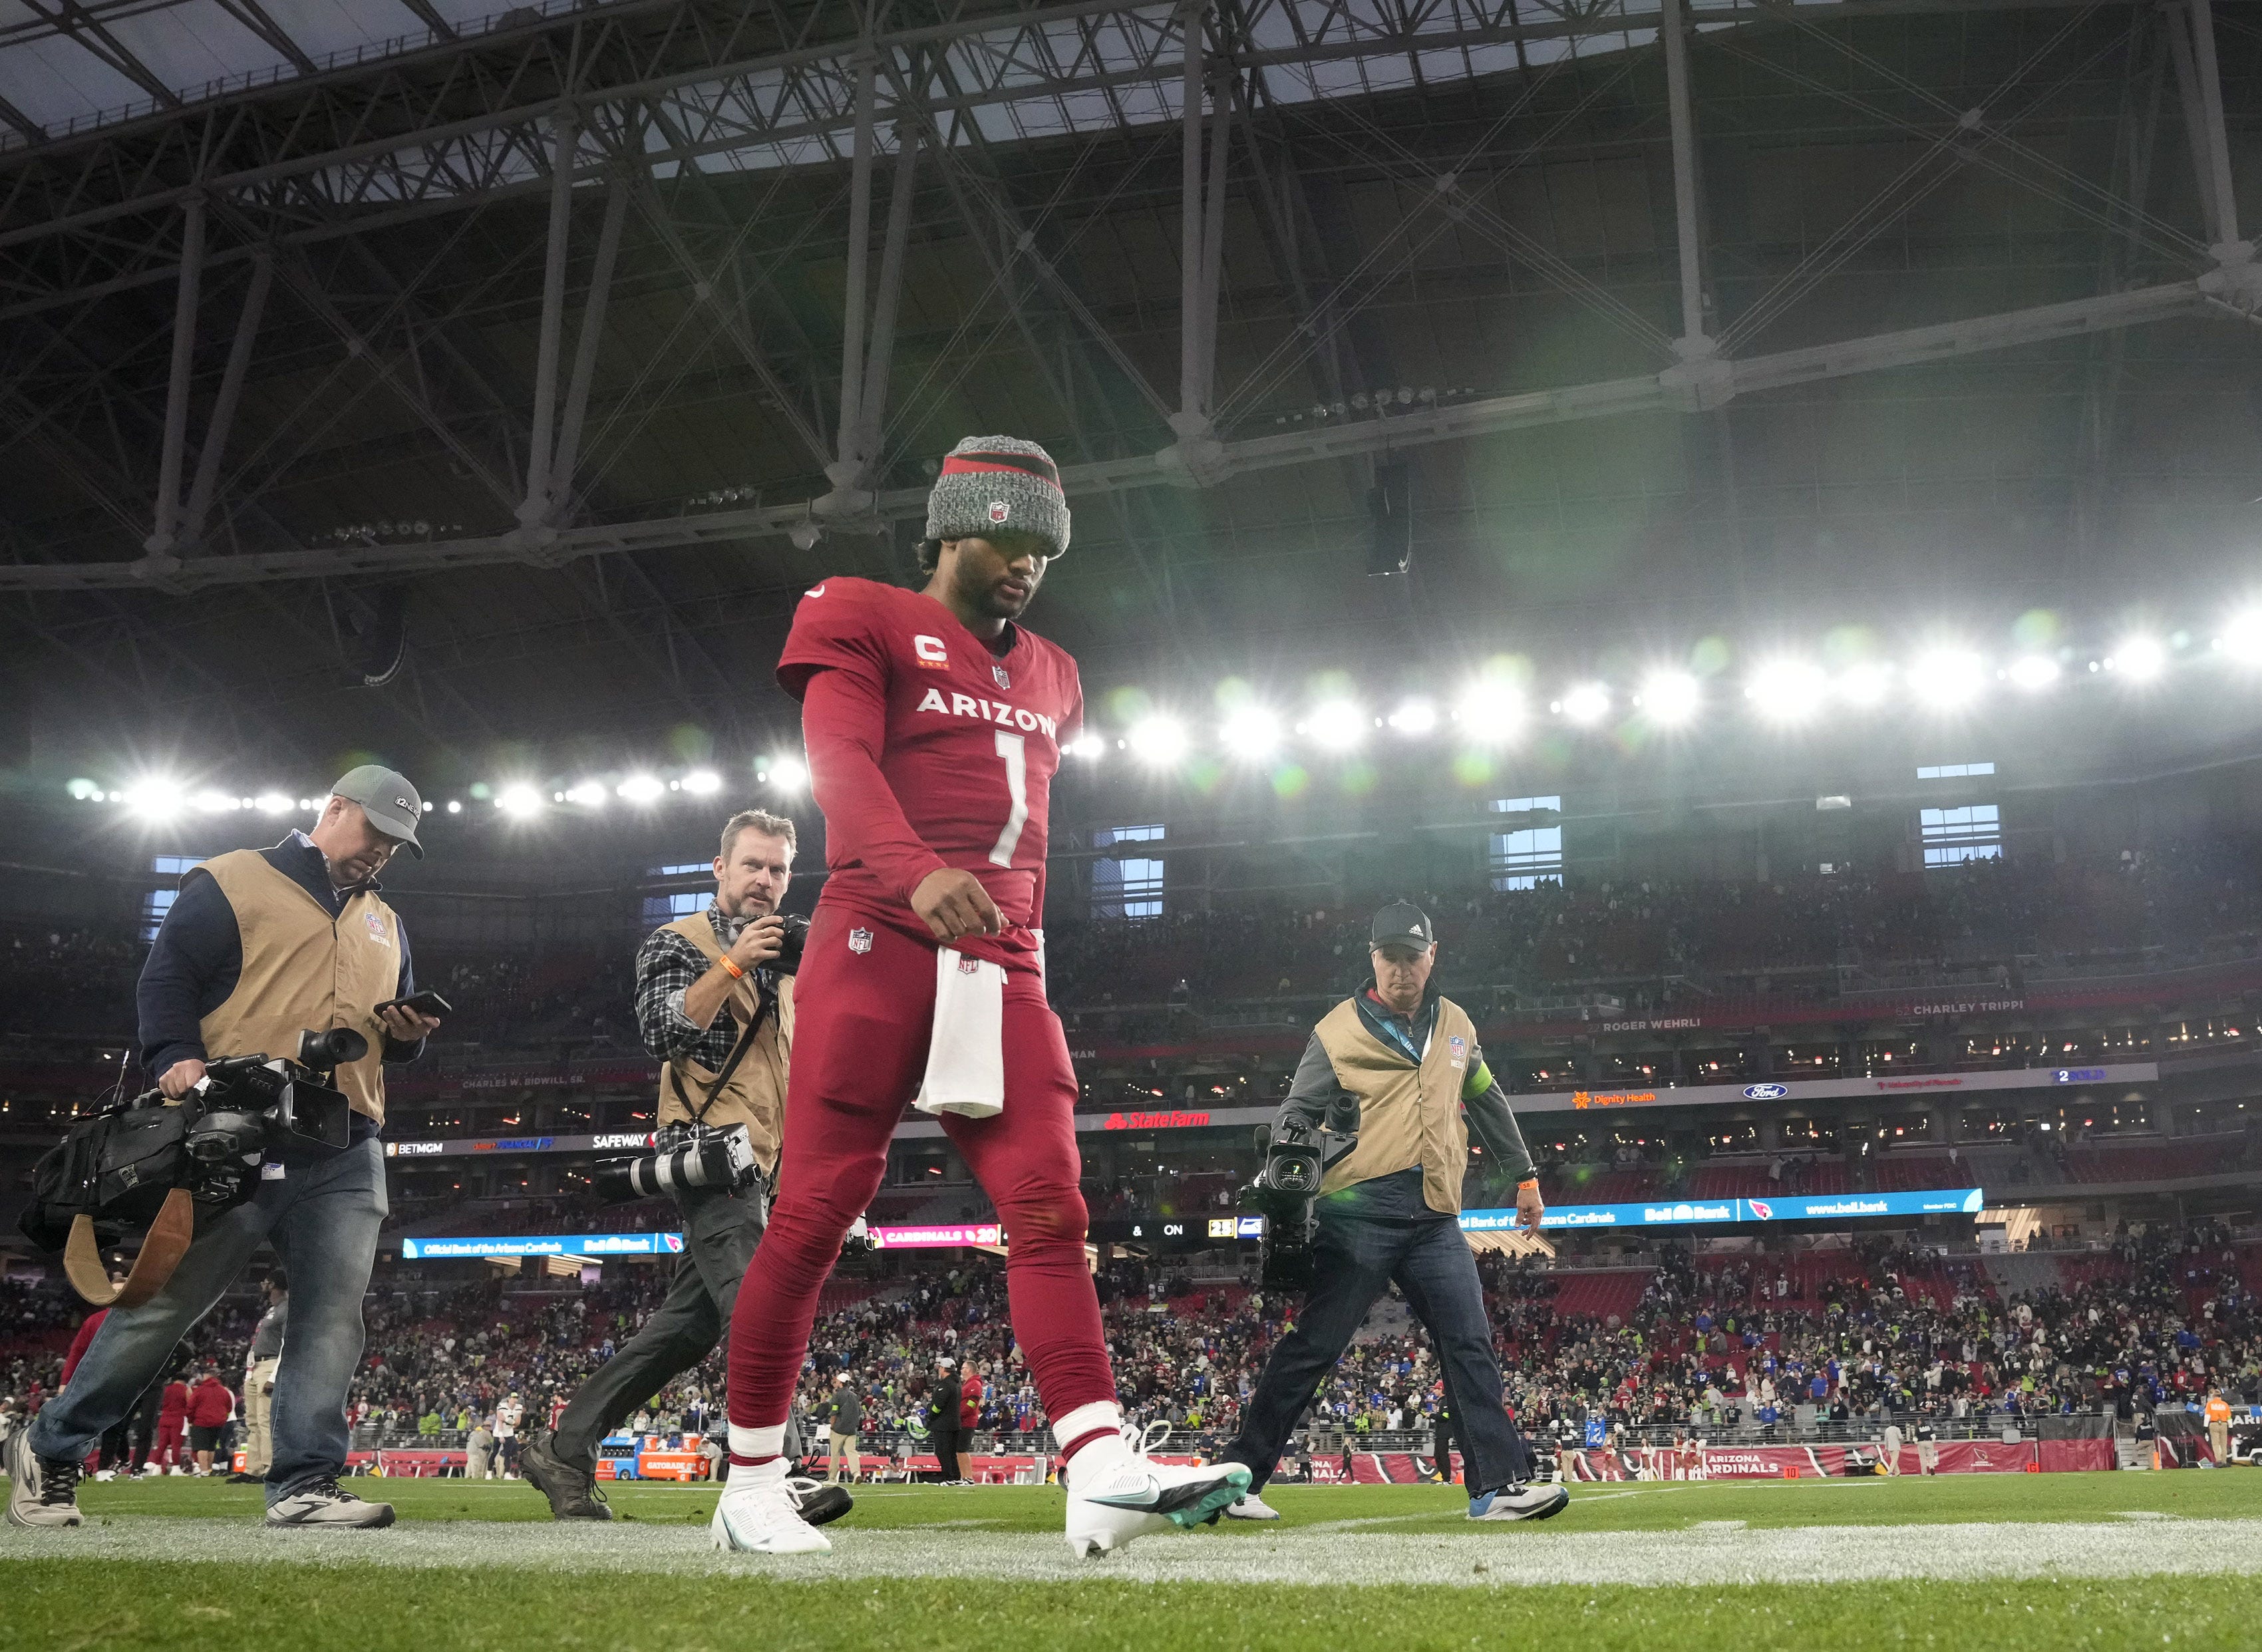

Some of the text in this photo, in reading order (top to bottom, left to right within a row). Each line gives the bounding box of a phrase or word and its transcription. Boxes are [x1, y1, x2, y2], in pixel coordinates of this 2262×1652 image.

[914, 634, 947, 662] C
[916, 688, 1056, 740] ARIZON
[989, 730, 1029, 869] 1
[959, 959, 977, 971] NFL
[1913, 1003, 1975, 1015] CHARLEY
[1980, 1000, 2023, 1011] TRIPPI
[1603, 1021, 1646, 1031] ROGER
[1651, 1018, 1700, 1029] WEHRLI
[462, 1078, 507, 1088] CHARLES
[1751, 1086, 1779, 1098] Ford
[1594, 1092, 1655, 1106] Dignity Health
[593, 1134, 647, 1148] SAFEWAY
[398, 1142, 443, 1154] BETMGM
[1645, 1205, 1730, 1222] Bell Bank
[1806, 1200, 1887, 1215] www.bell.bank
[1470, 1216, 1496, 1228] Bank
[1497, 1216, 1509, 1227] of
[1567, 1212, 1615, 1224] Cardinals
[1133, 1224, 1183, 1236] & ON
[1211, 1221, 1232, 1236] 25
[886, 1228, 997, 1243] CARDINALS 20
[424, 1241, 562, 1254] Official Bank of the Arizona Cardinals
[236, 1455, 245, 1467] G
[1708, 1454, 1761, 1463] ARIZONA
[699, 1461, 705, 1470] G
[1704, 1463, 1778, 1474] ARDINALS
[1786, 1468, 1796, 1478] 10
